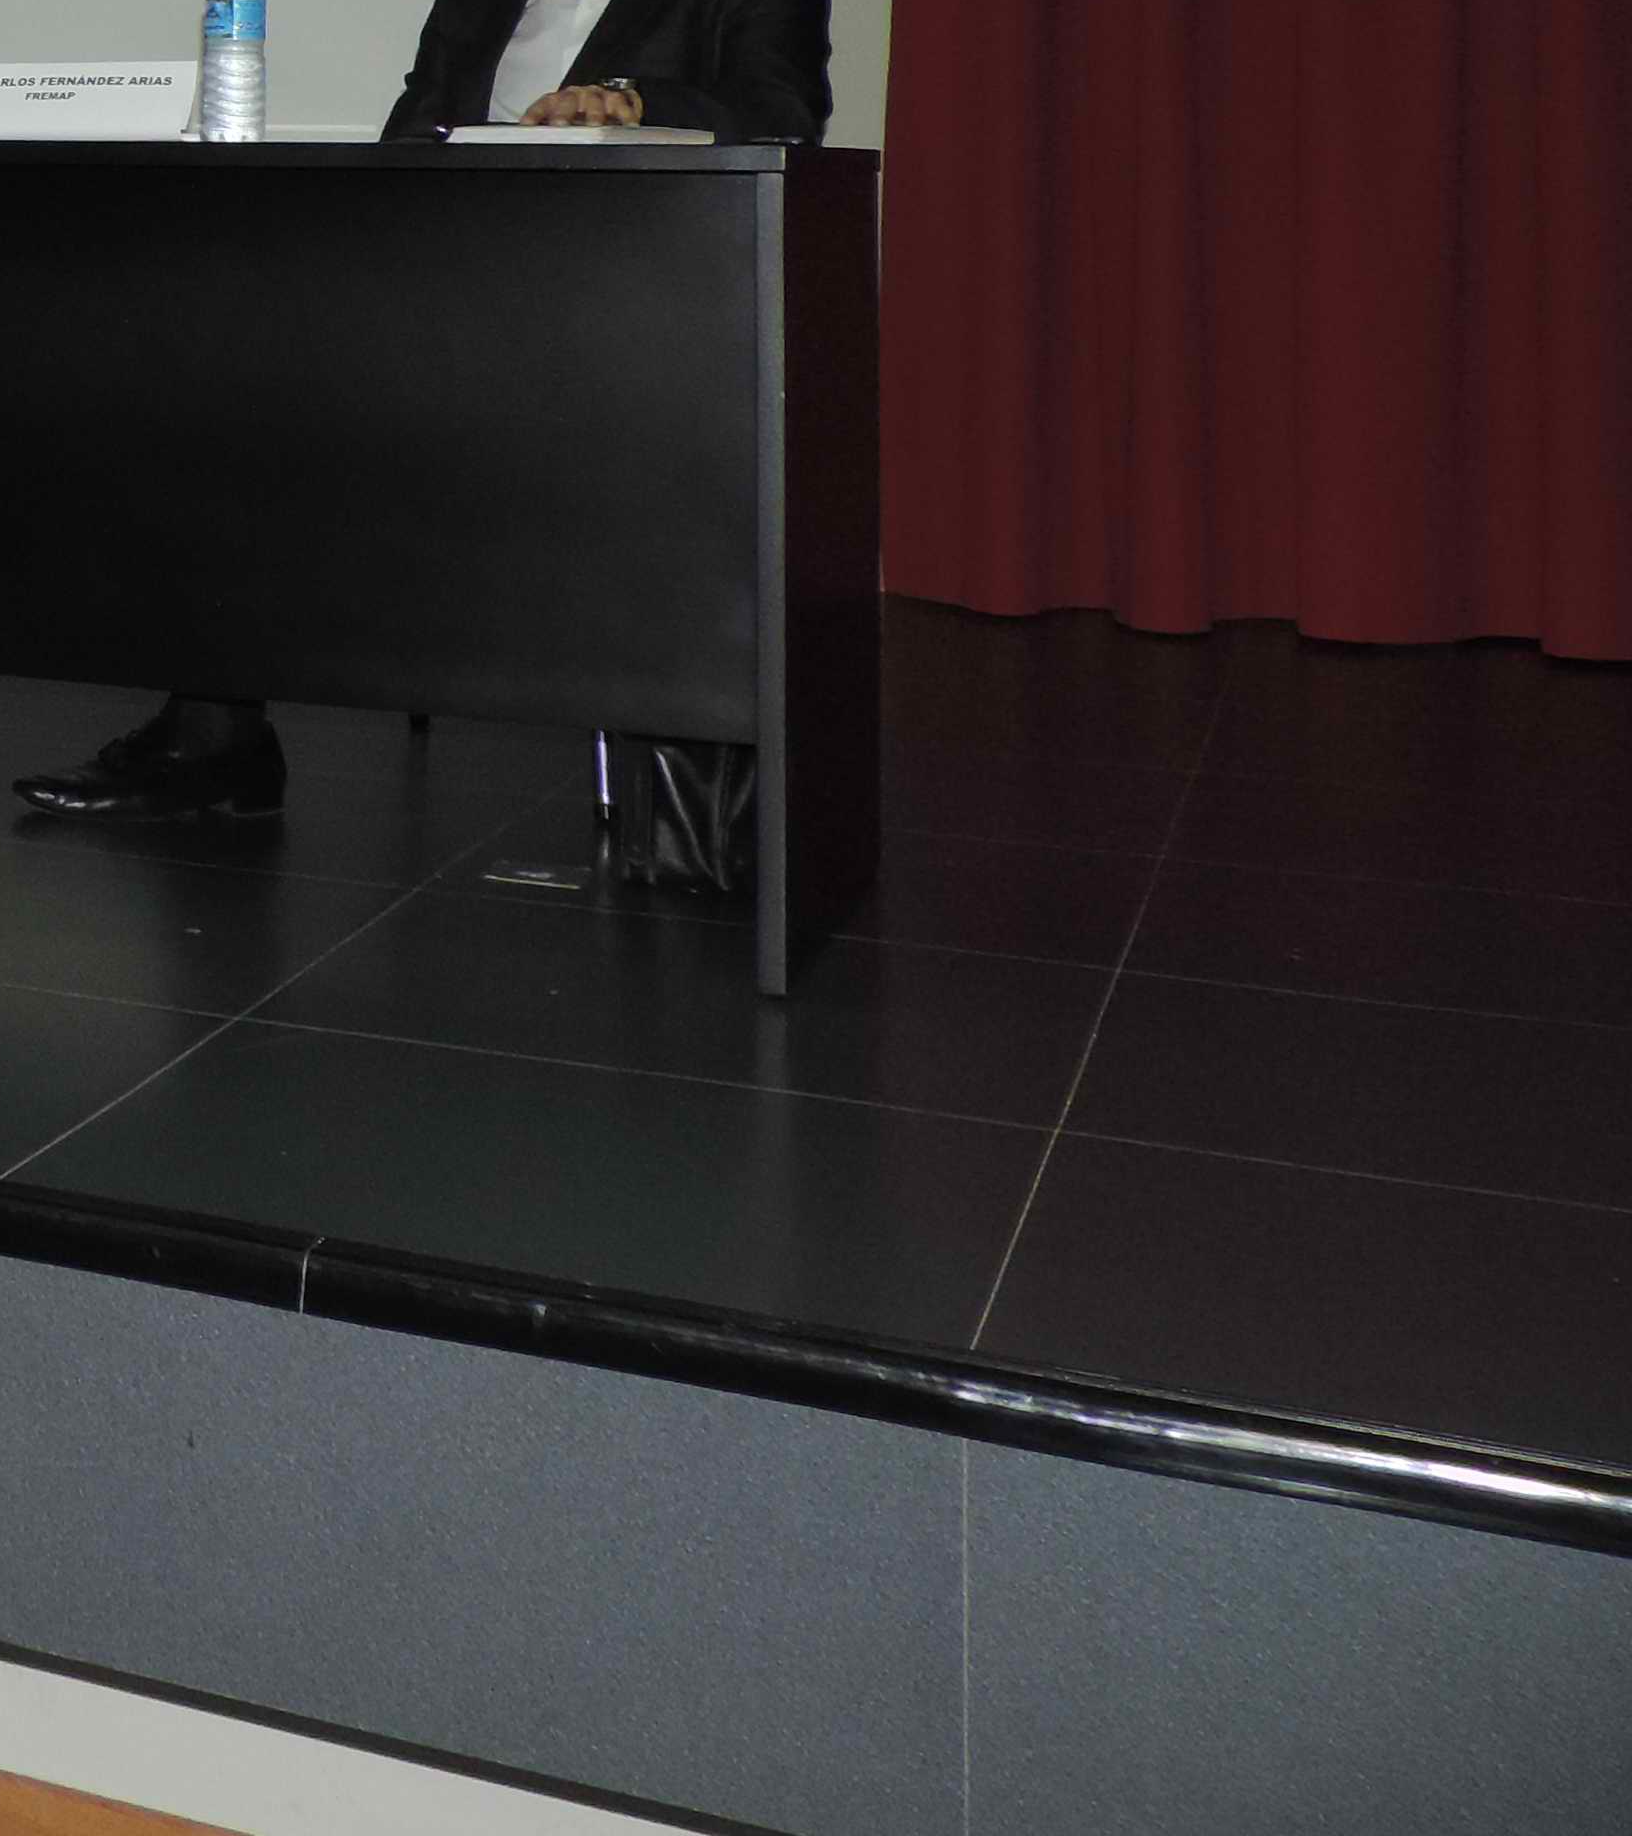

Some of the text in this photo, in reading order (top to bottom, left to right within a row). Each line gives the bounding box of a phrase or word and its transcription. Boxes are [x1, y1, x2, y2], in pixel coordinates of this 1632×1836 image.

[39, 73, 125, 87] FERNÁNDEZ
[128, 75, 173, 86] ARIAS
[25, 91, 76, 101] FREMAP
